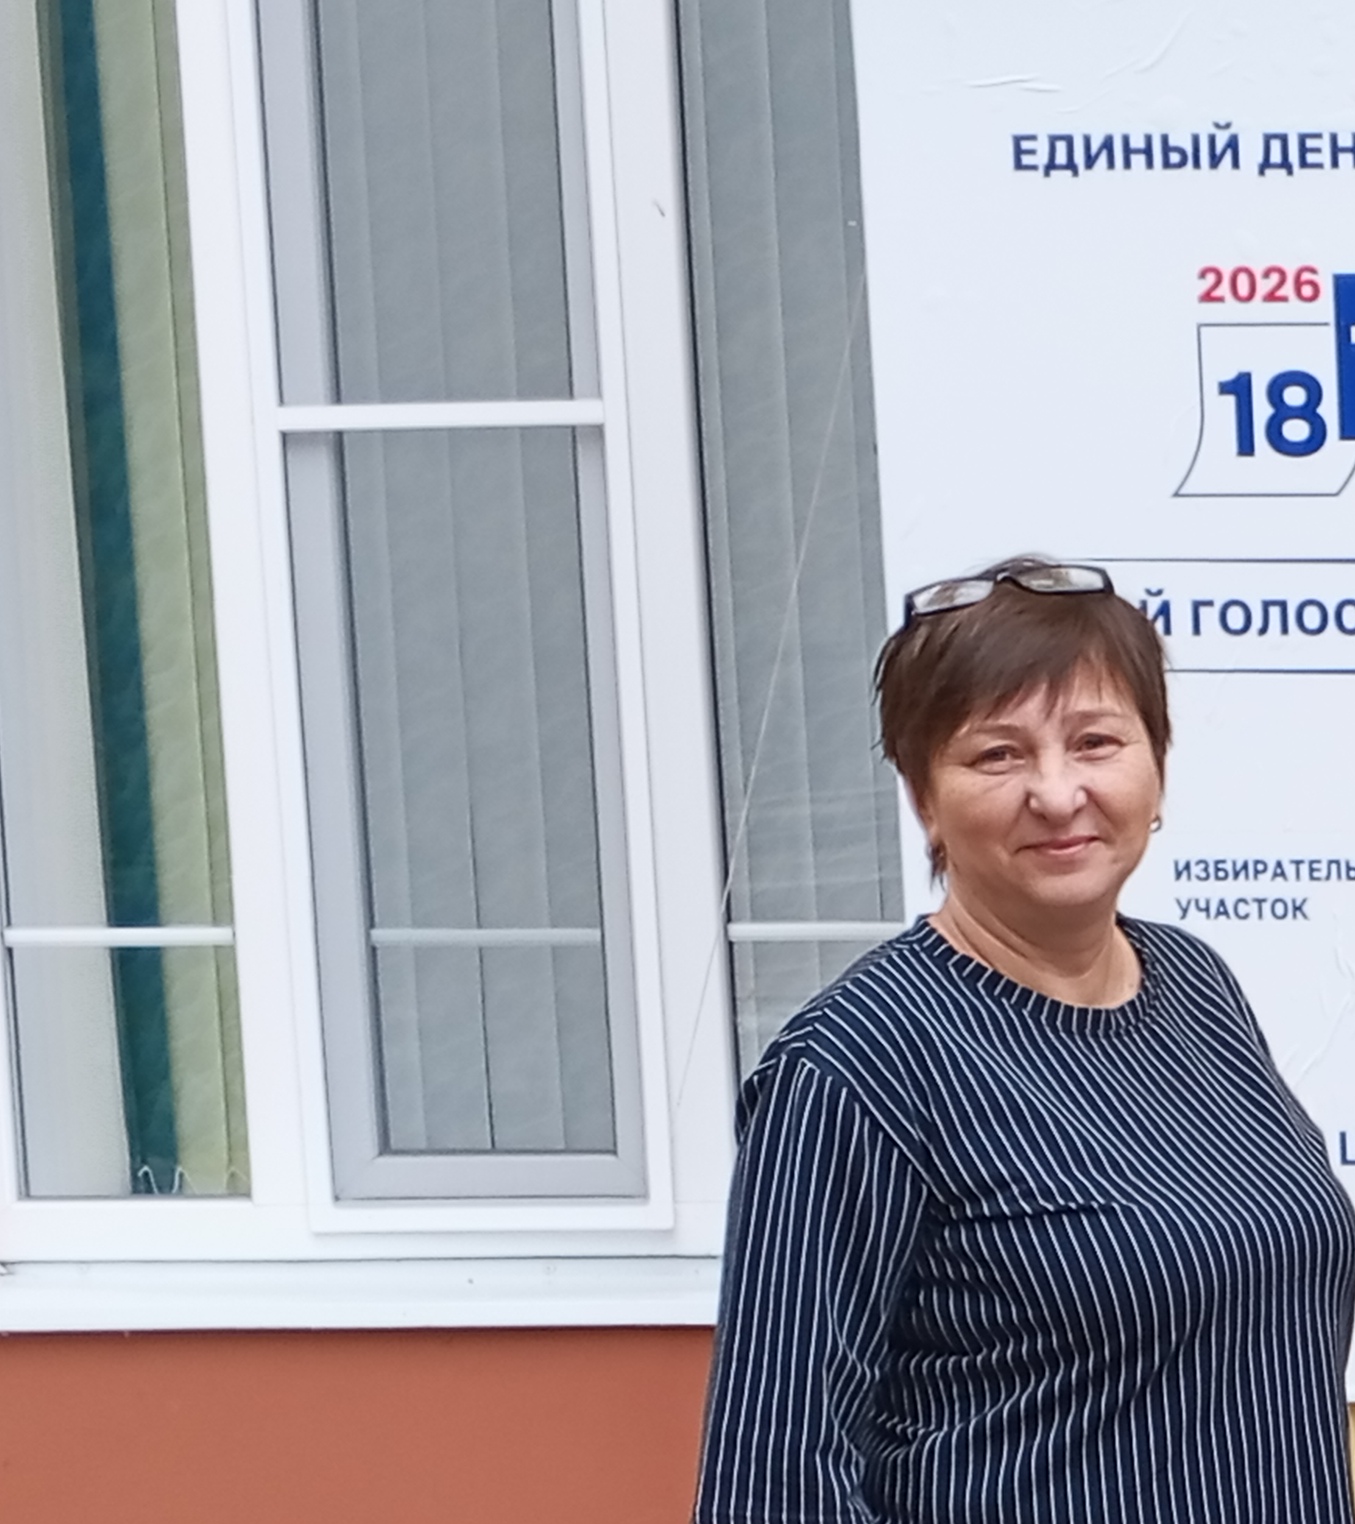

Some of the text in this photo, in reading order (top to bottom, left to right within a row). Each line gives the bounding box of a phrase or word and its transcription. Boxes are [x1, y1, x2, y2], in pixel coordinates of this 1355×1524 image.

[1011, 121, 1241, 178] ЕДИНЫЙ
[1198, 265, 1321, 304] 2026
[1217, 369, 1328, 458] 18
[1175, 897, 1310, 921] УЧАСТОК
